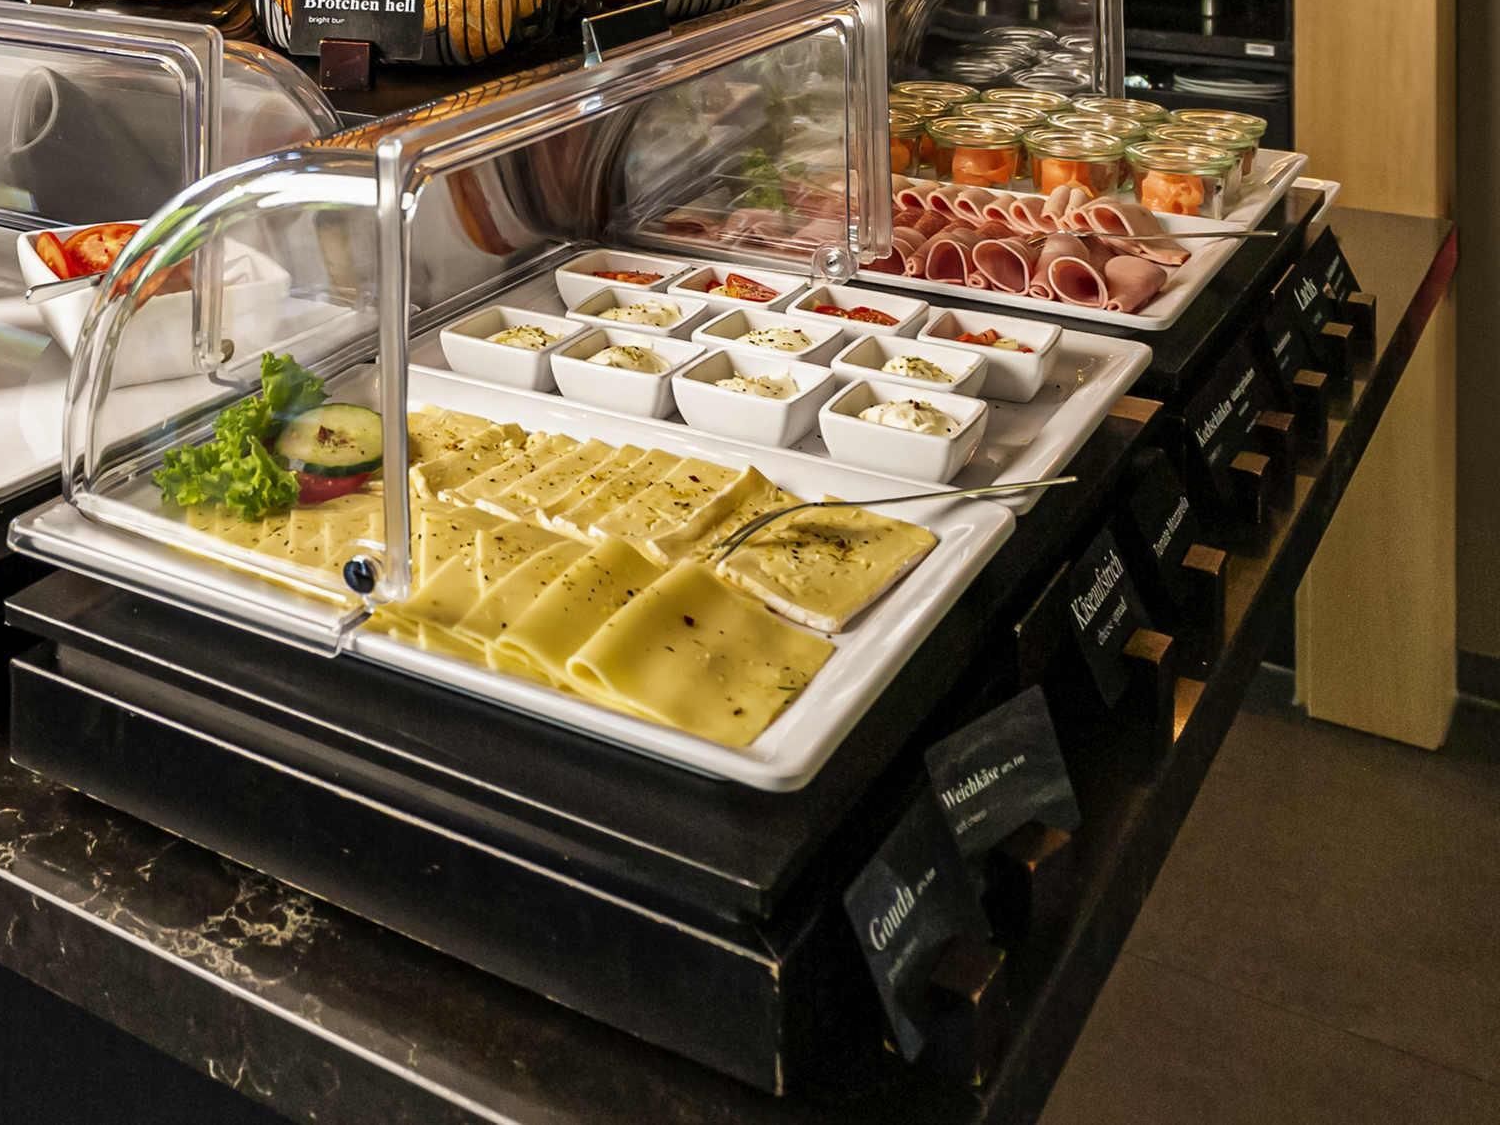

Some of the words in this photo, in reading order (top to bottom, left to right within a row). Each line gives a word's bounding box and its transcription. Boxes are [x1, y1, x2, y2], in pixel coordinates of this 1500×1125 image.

[308, 15, 331, 25] bright
[1293, 276, 1319, 311] Lachs
[1070, 549, 1125, 631] Käseaufstrich
[941, 766, 1000, 810] Weichkäse
[869, 886, 916, 952] Gouda
